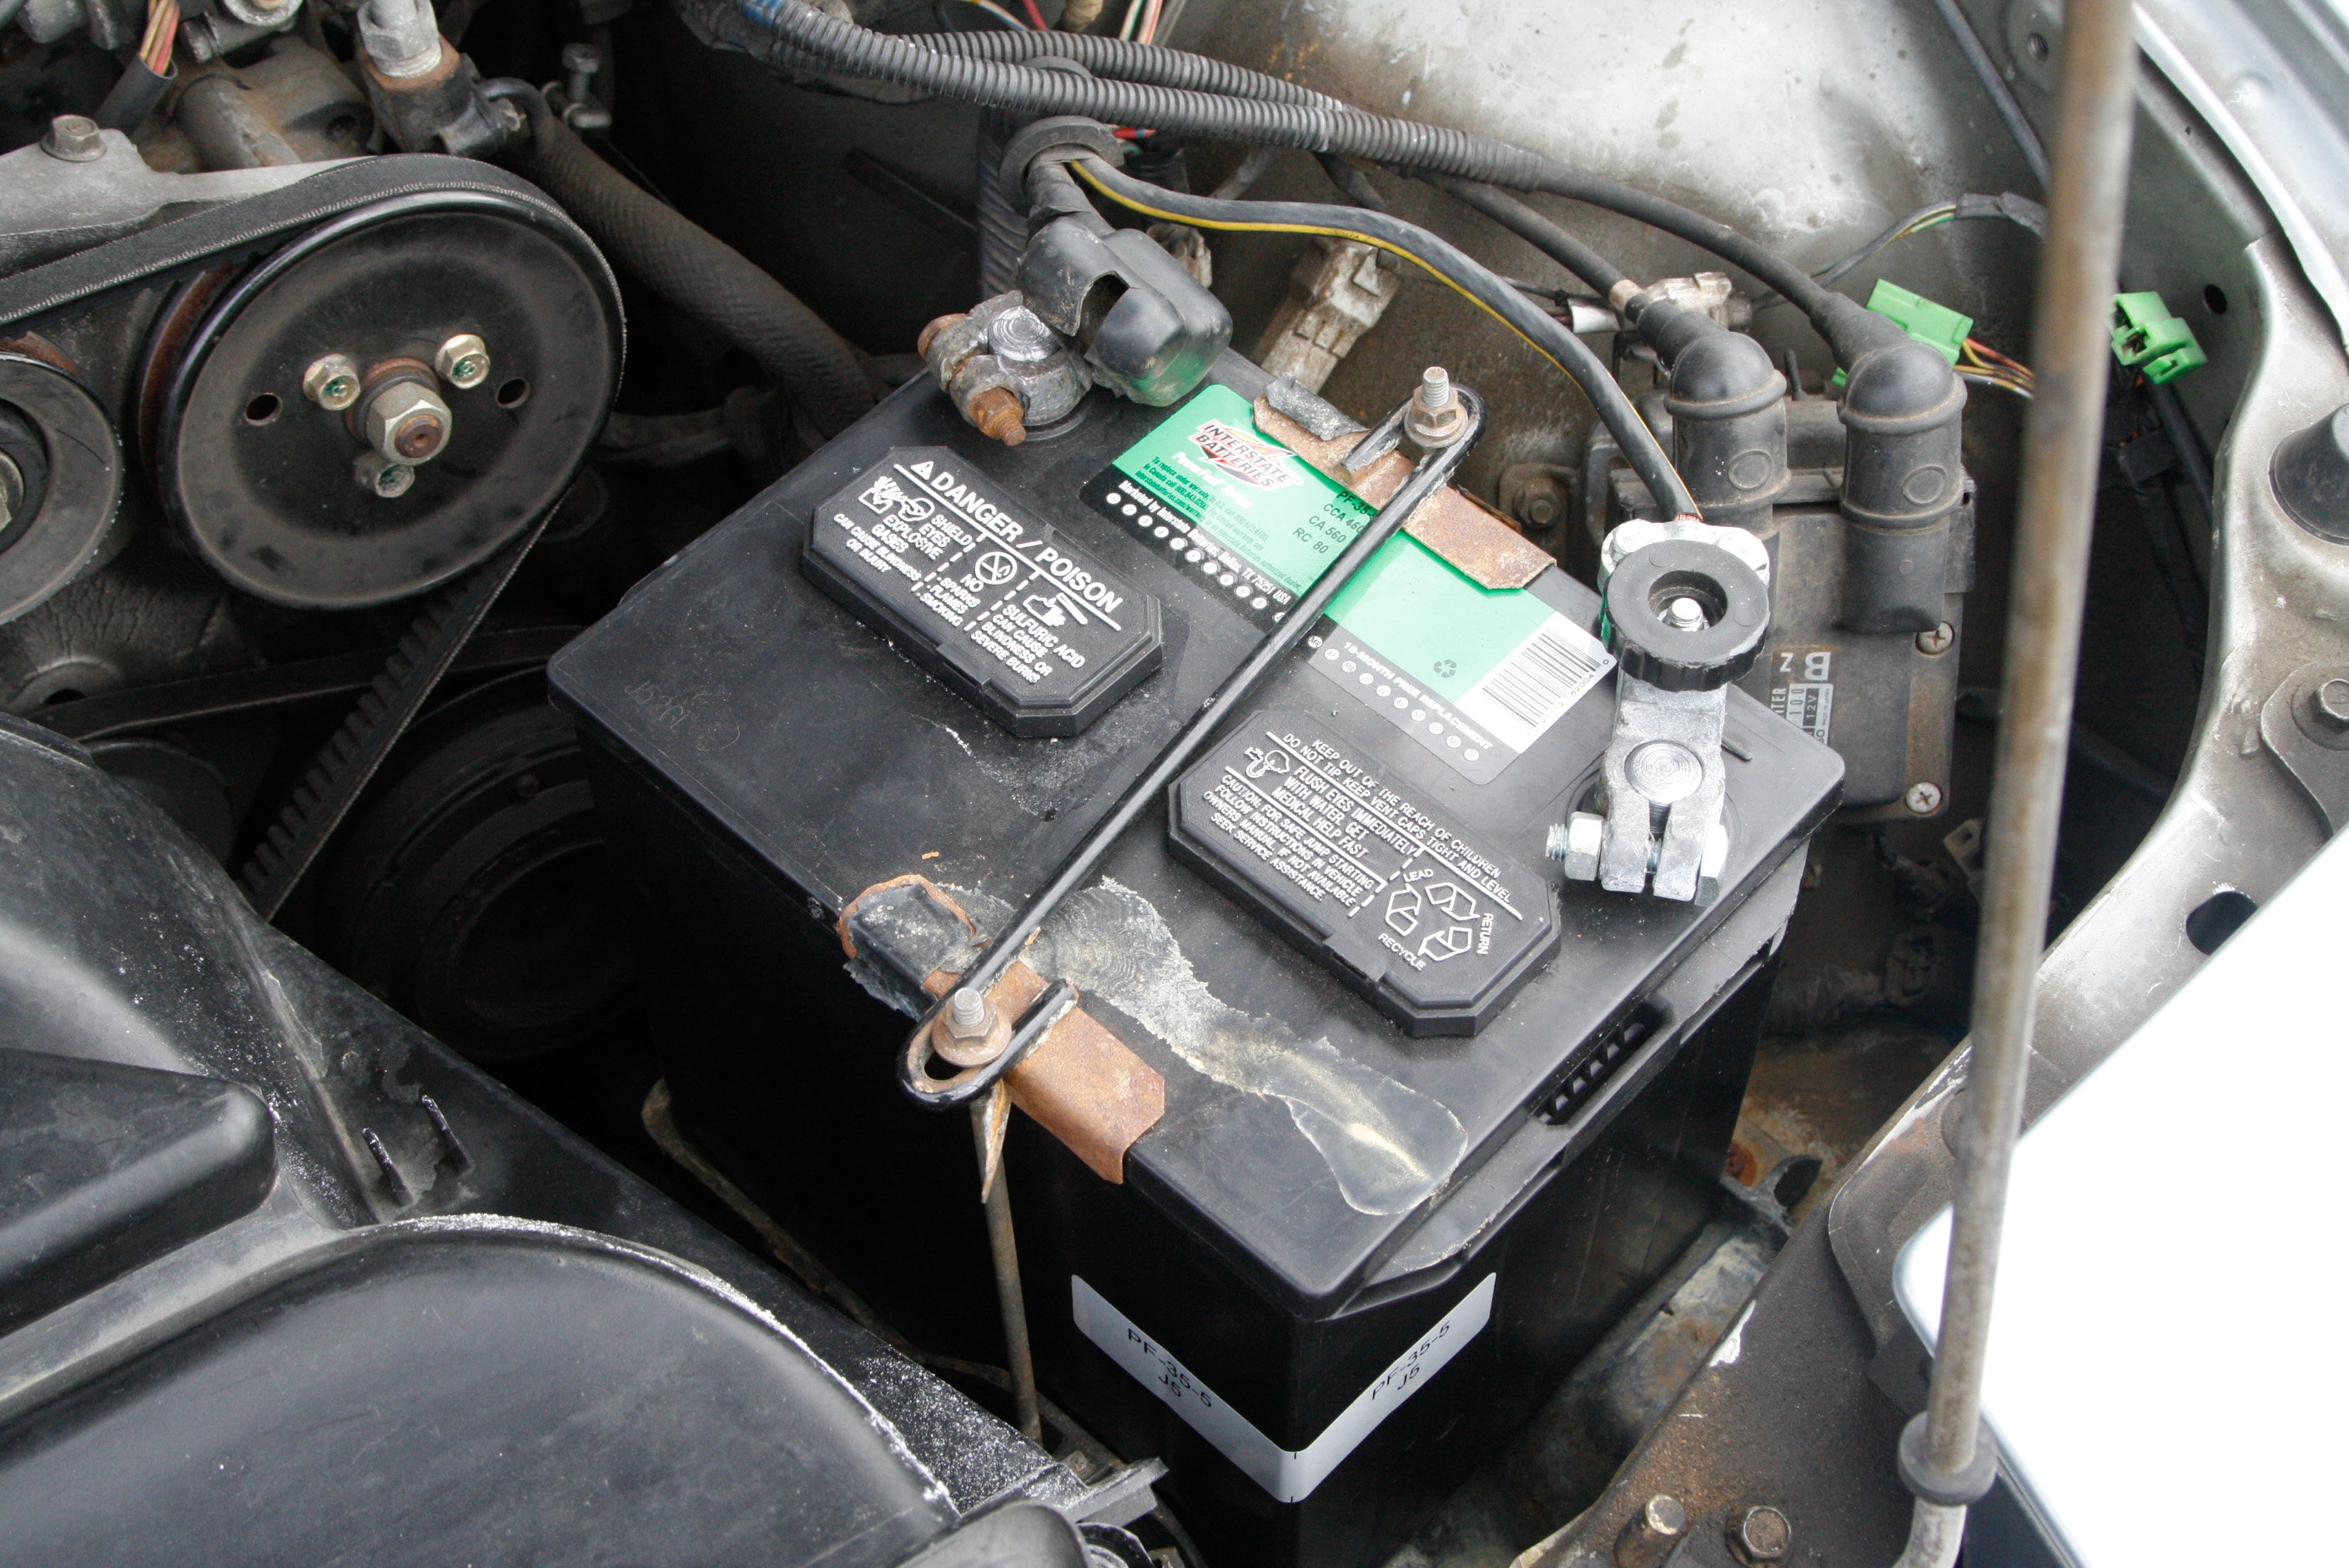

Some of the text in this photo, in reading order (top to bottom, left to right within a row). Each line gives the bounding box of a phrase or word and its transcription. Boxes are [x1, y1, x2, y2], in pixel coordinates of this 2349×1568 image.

[1150, 455, 1162, 465] To
[1156, 460, 1179, 477] replace
[1174, 472, 1191, 485] under
[1195, 432, 1275, 487] BATTERIES
[1204, 422, 1292, 484] INTERSTATE
[1147, 465, 1169, 482] Canada
[1164, 477, 1178, 488] call
[918, 522, 950, 547] EYES
[931, 514, 972, 545] SHIELD
[1306, 514, 1348, 544] CA 560
[1320, 502, 1348, 521] CCA
[833, 513, 922, 580] CAN CAUSE BLINDNESS
[846, 538, 891, 572] OR INJURY
[871, 523, 908, 552] GASES
[883, 514, 943, 560] EXPLOSIVE
[930, 471, 1023, 542] DANGER
[1034, 546, 1123, 612] POISON
[1117, 478, 1294, 606] Marketed by Interstate Batteries, Dallas, TX 75251 USA
[1291, 526, 1330, 555] RC 80
[959, 573, 983, 591] NO
[1238, 544, 1263, 562] Batteries
[1258, 558, 1288, 580] authorized
[1281, 574, 1305, 591] dealer.
[919, 592, 963, 626] SMOKING
[929, 584, 968, 613] FLAMES
[939, 577, 980, 607] SPARKS
[970, 630, 1040, 682] SEVERE BURNS
[981, 621, 1052, 676] BLINDNESS OR
[992, 614, 1048, 657] CAN CAUSE
[1002, 604, 1084, 667] SULFURIC ACID
[1340, 640, 1494, 750] 18-MONTH FREE REPLACEMENT
[1770, 688, 1787, 717] ITER
[1806, 695, 1817, 719] 12V
[1271, 786, 1368, 857] MEDICAL HELP FAST
[1282, 733, 1510, 902] DO NOT TIP. KEEP VENT CAPS TIGHT AND LEVEL
[1284, 776, 1369, 840] WITH WATER. GET
[1293, 766, 1417, 854] FLUSH EYES IMMEDIATELY
[1311, 739, 1501, 877] KEEP OUT OF THE REACH OF CHILDREN
[1204, 791, 1356, 906] OWNERS MANUAL. IF NOT AVAILABLE
[1215, 784, 1362, 896] FOLLOW INSTRUCTIONS IN VEHICLE
[1221, 774, 1374, 889] CAUTION: FOR SAFE JUMP STARTING
[1210, 812, 1325, 901] SEEK SERVICE ASSISTANCE.
[1403, 869, 1435, 882] LEAD
[1377, 932, 1426, 970] RECYCLE
[1476, 912, 1493, 955] RETURN
[1128, 1328, 1212, 1407] PF-35-5
[1372, 1320, 1450, 1400] PF-35-5
[1397, 1362, 1420, 1390] J5
[1158, 1374, 1181, 1397] J5
